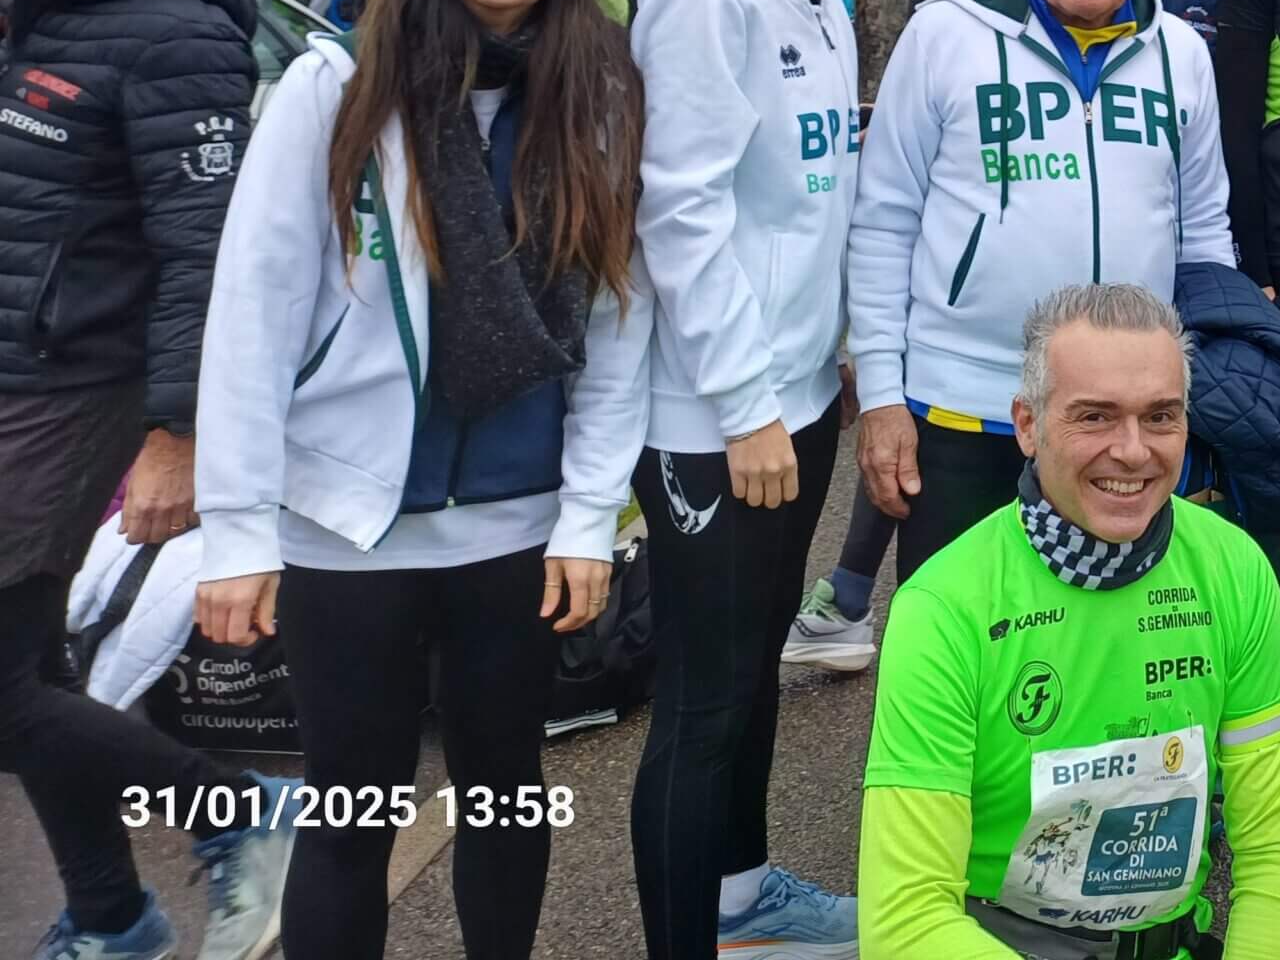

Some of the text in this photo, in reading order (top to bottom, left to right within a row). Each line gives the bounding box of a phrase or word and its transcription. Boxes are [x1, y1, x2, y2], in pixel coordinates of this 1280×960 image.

[0, 108, 68, 142] STEFANO
[981, 148, 1080, 183] Banca
[1148, 588, 1197, 606] CORRIDA
[1013, 607, 1065, 632] KARHU
[1145, 655, 1212, 685] BPER:
[1146, 689, 1172, 701] Banca
[1052, 753, 1137, 785] BPER:
[1101, 835, 1178, 856] CORRIDA
[1129, 854, 1144, 867] DI
[1086, 866, 1182, 882] SAN GEMINIANO
[1069, 905, 1148, 923] KARHU
